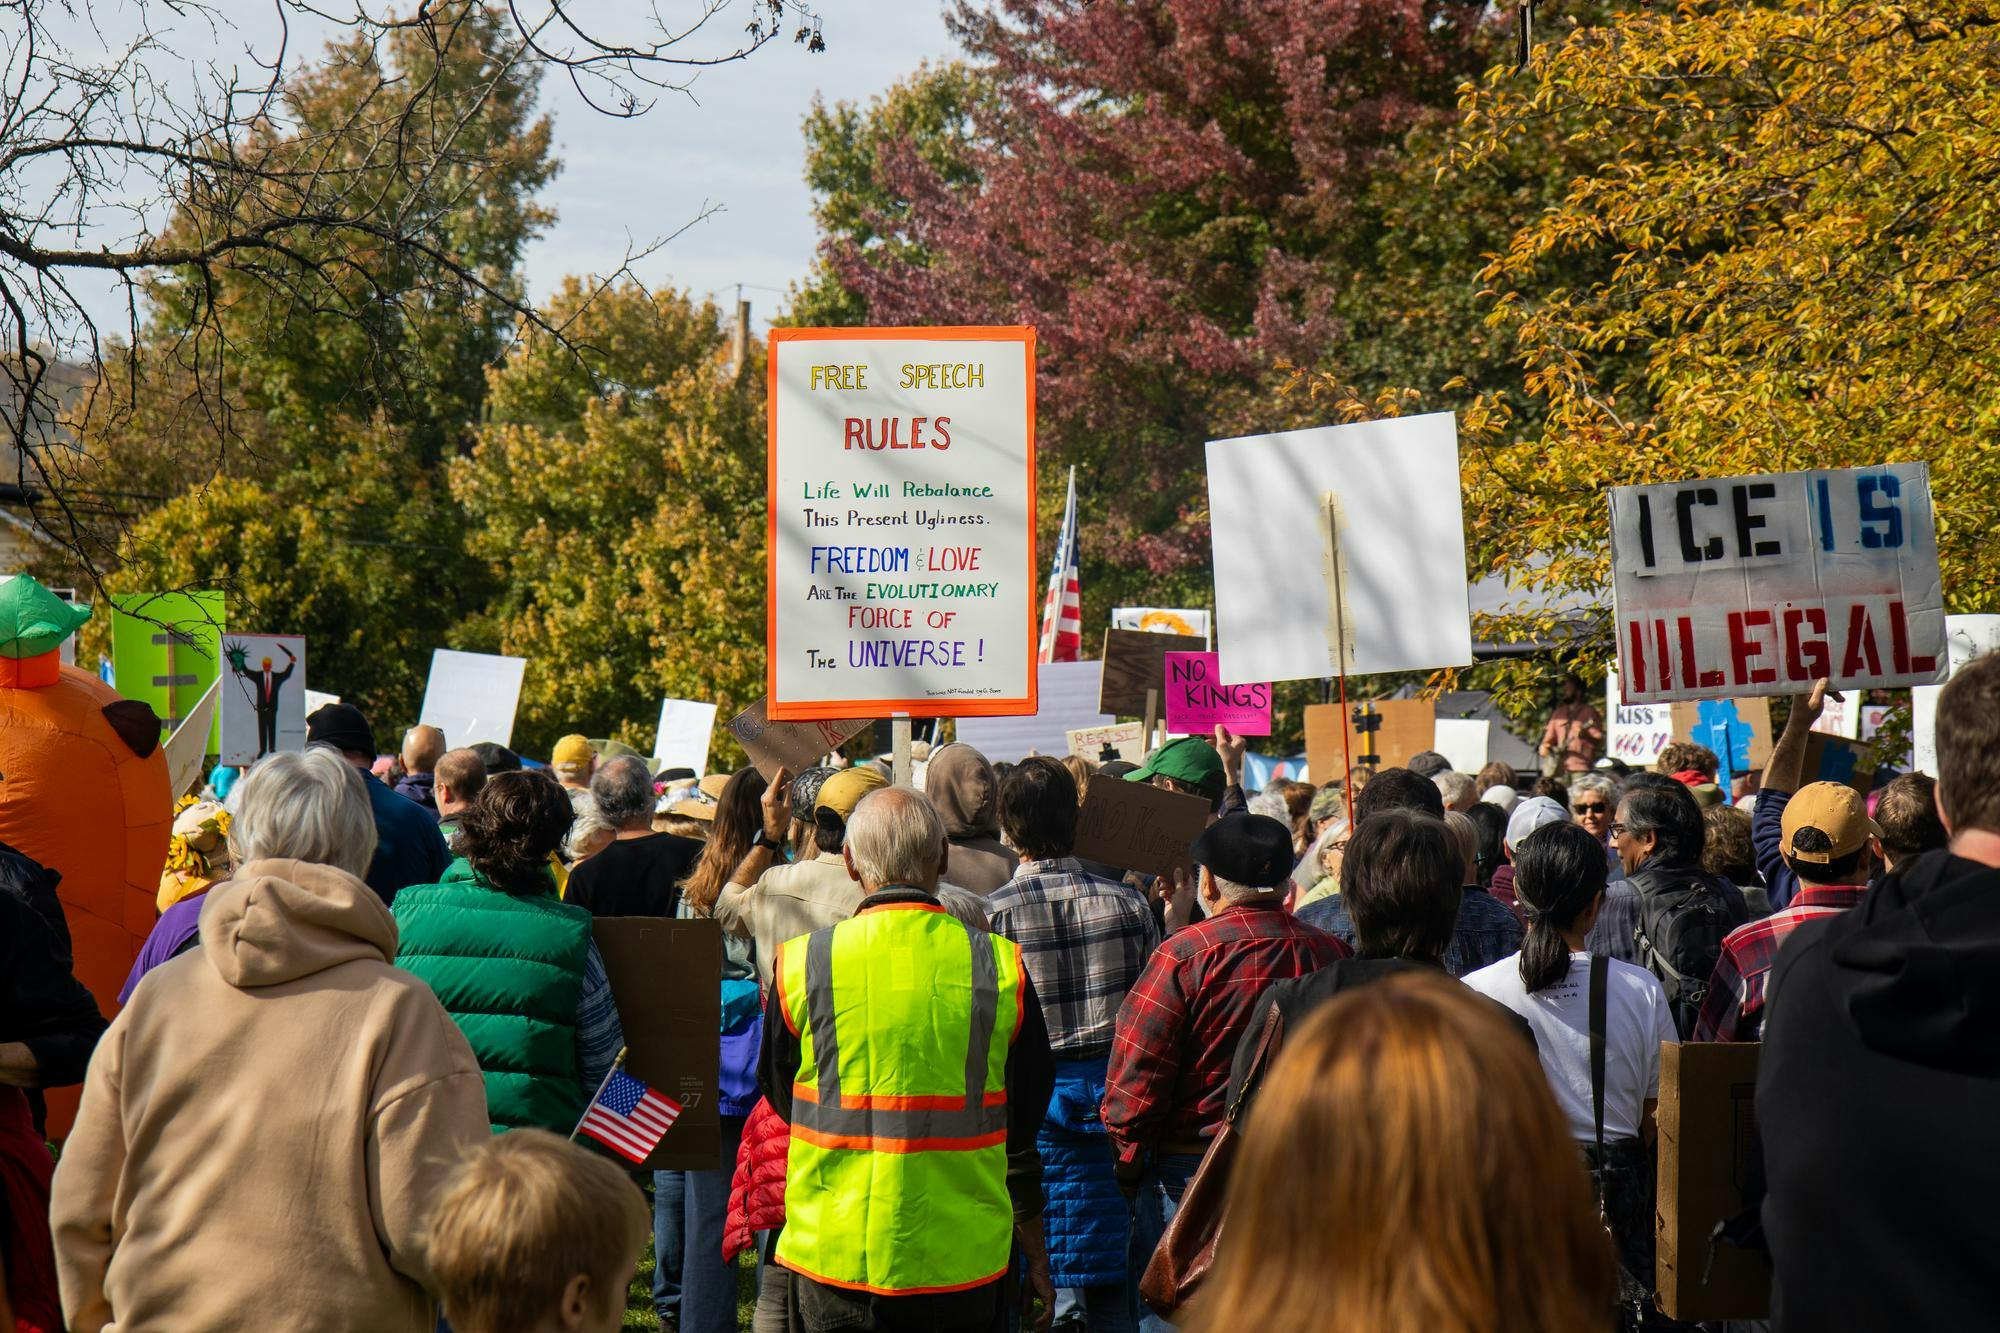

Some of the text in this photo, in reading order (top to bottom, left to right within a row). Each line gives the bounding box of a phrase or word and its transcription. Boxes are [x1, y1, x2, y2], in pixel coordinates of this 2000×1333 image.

[811, 363, 984, 390] FREE SPEECH
[844, 416, 951, 450] RULES
[803, 481, 994, 499] Life Will Rebalance
[803, 508, 990, 530] This Present Ugliness.
[1638, 475, 1904, 567] ICE IS
[811, 546, 909, 574] FREEDOM
[928, 546, 982, 572] LOVE
[866, 582, 999, 600] EVOLUTIONARY
[848, 606, 956, 629] FORCE OF
[849, 640, 966, 668] UNIVERSE
[1172, 659, 1206, 683] NO
[1185, 683, 1267, 709] KINGS
[680, 1093, 702, 1108] 27
